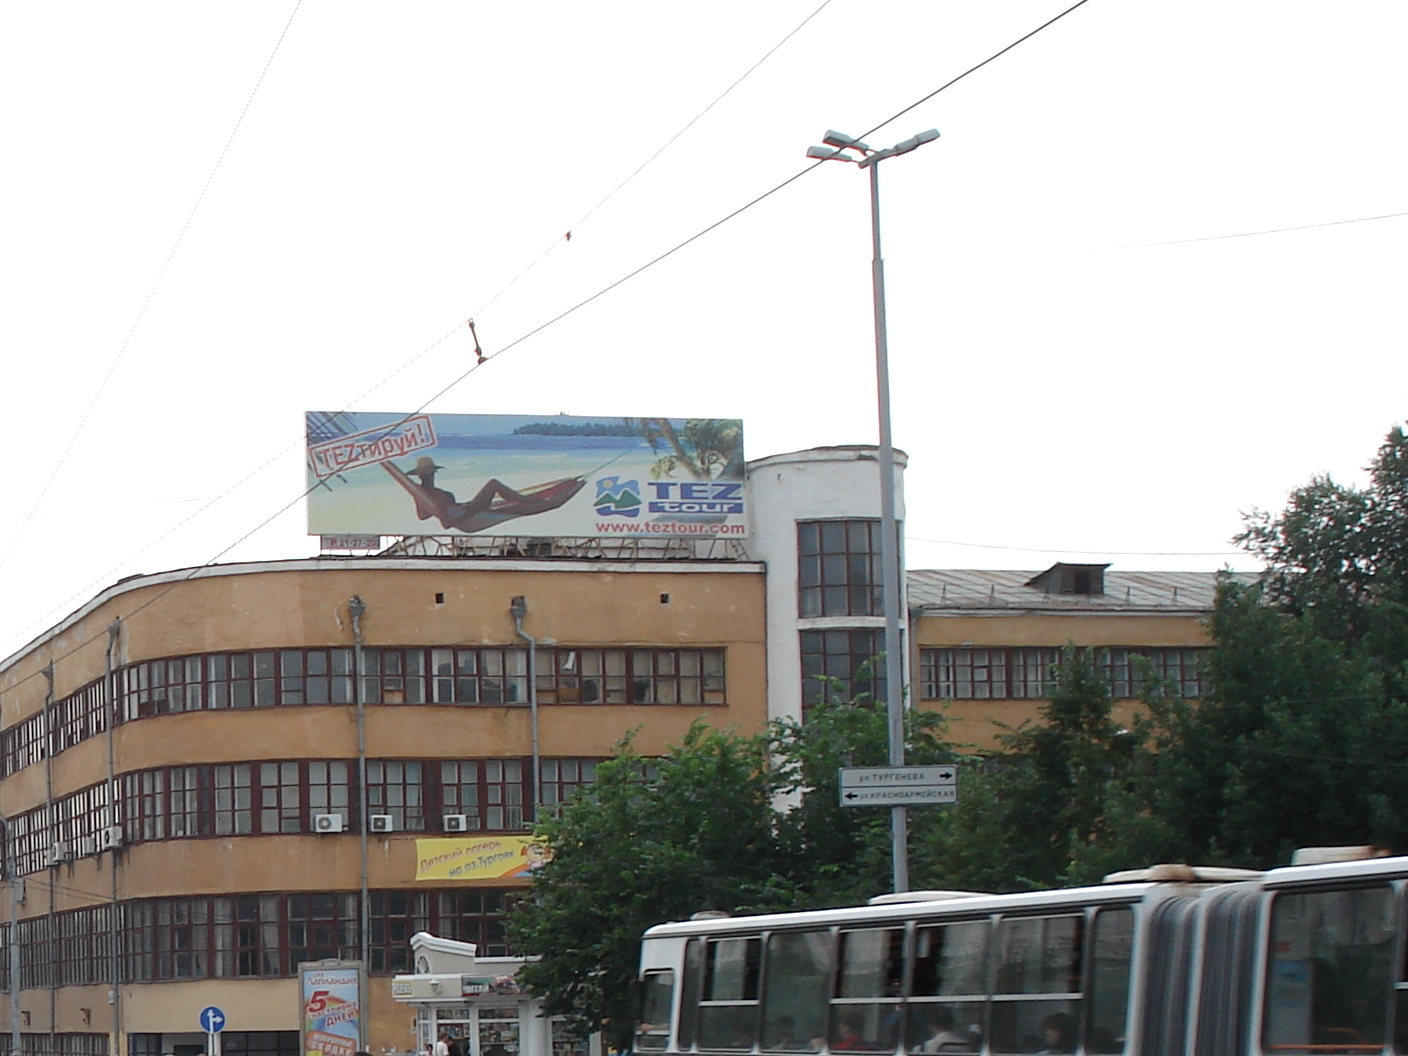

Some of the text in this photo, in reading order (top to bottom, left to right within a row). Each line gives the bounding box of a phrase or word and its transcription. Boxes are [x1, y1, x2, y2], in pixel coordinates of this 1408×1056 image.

[648, 482, 743, 500] TEZ
[657, 502, 735, 513] tour
[595, 521, 745, 534] www.teztour.com
[308, 991, 330, 1013] 5
